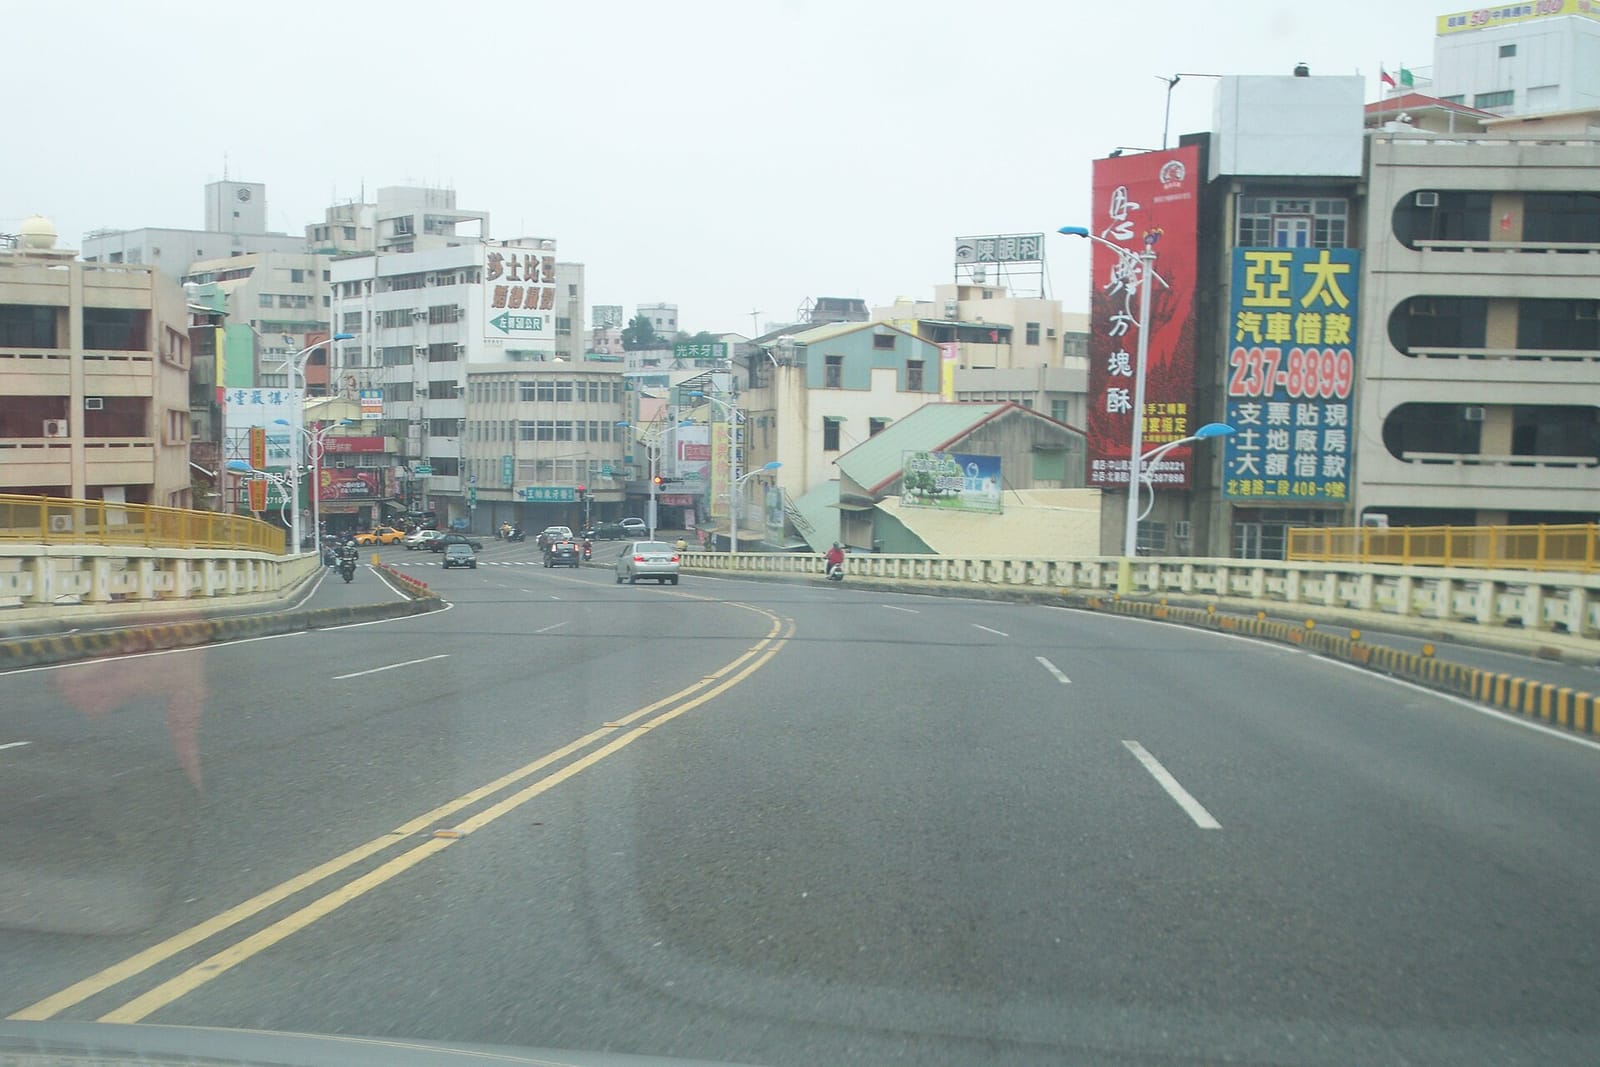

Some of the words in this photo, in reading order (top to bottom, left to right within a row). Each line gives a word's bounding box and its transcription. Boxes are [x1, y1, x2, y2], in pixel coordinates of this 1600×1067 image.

[977, 237, 1039, 260] 陳眼科
[486, 252, 556, 283] 莎士比亞
[1241, 250, 1350, 309] 亞太
[1236, 311, 1351, 344] 汽車借款
[676, 344, 724, 357] 光禾牙醫
[1229, 347, 1354, 398] 237-8899
[1237, 402, 1348, 427] 支票貼現
[1236, 428, 1347, 453] 土地廠房
[1235, 452, 1347, 478] 大額借款
